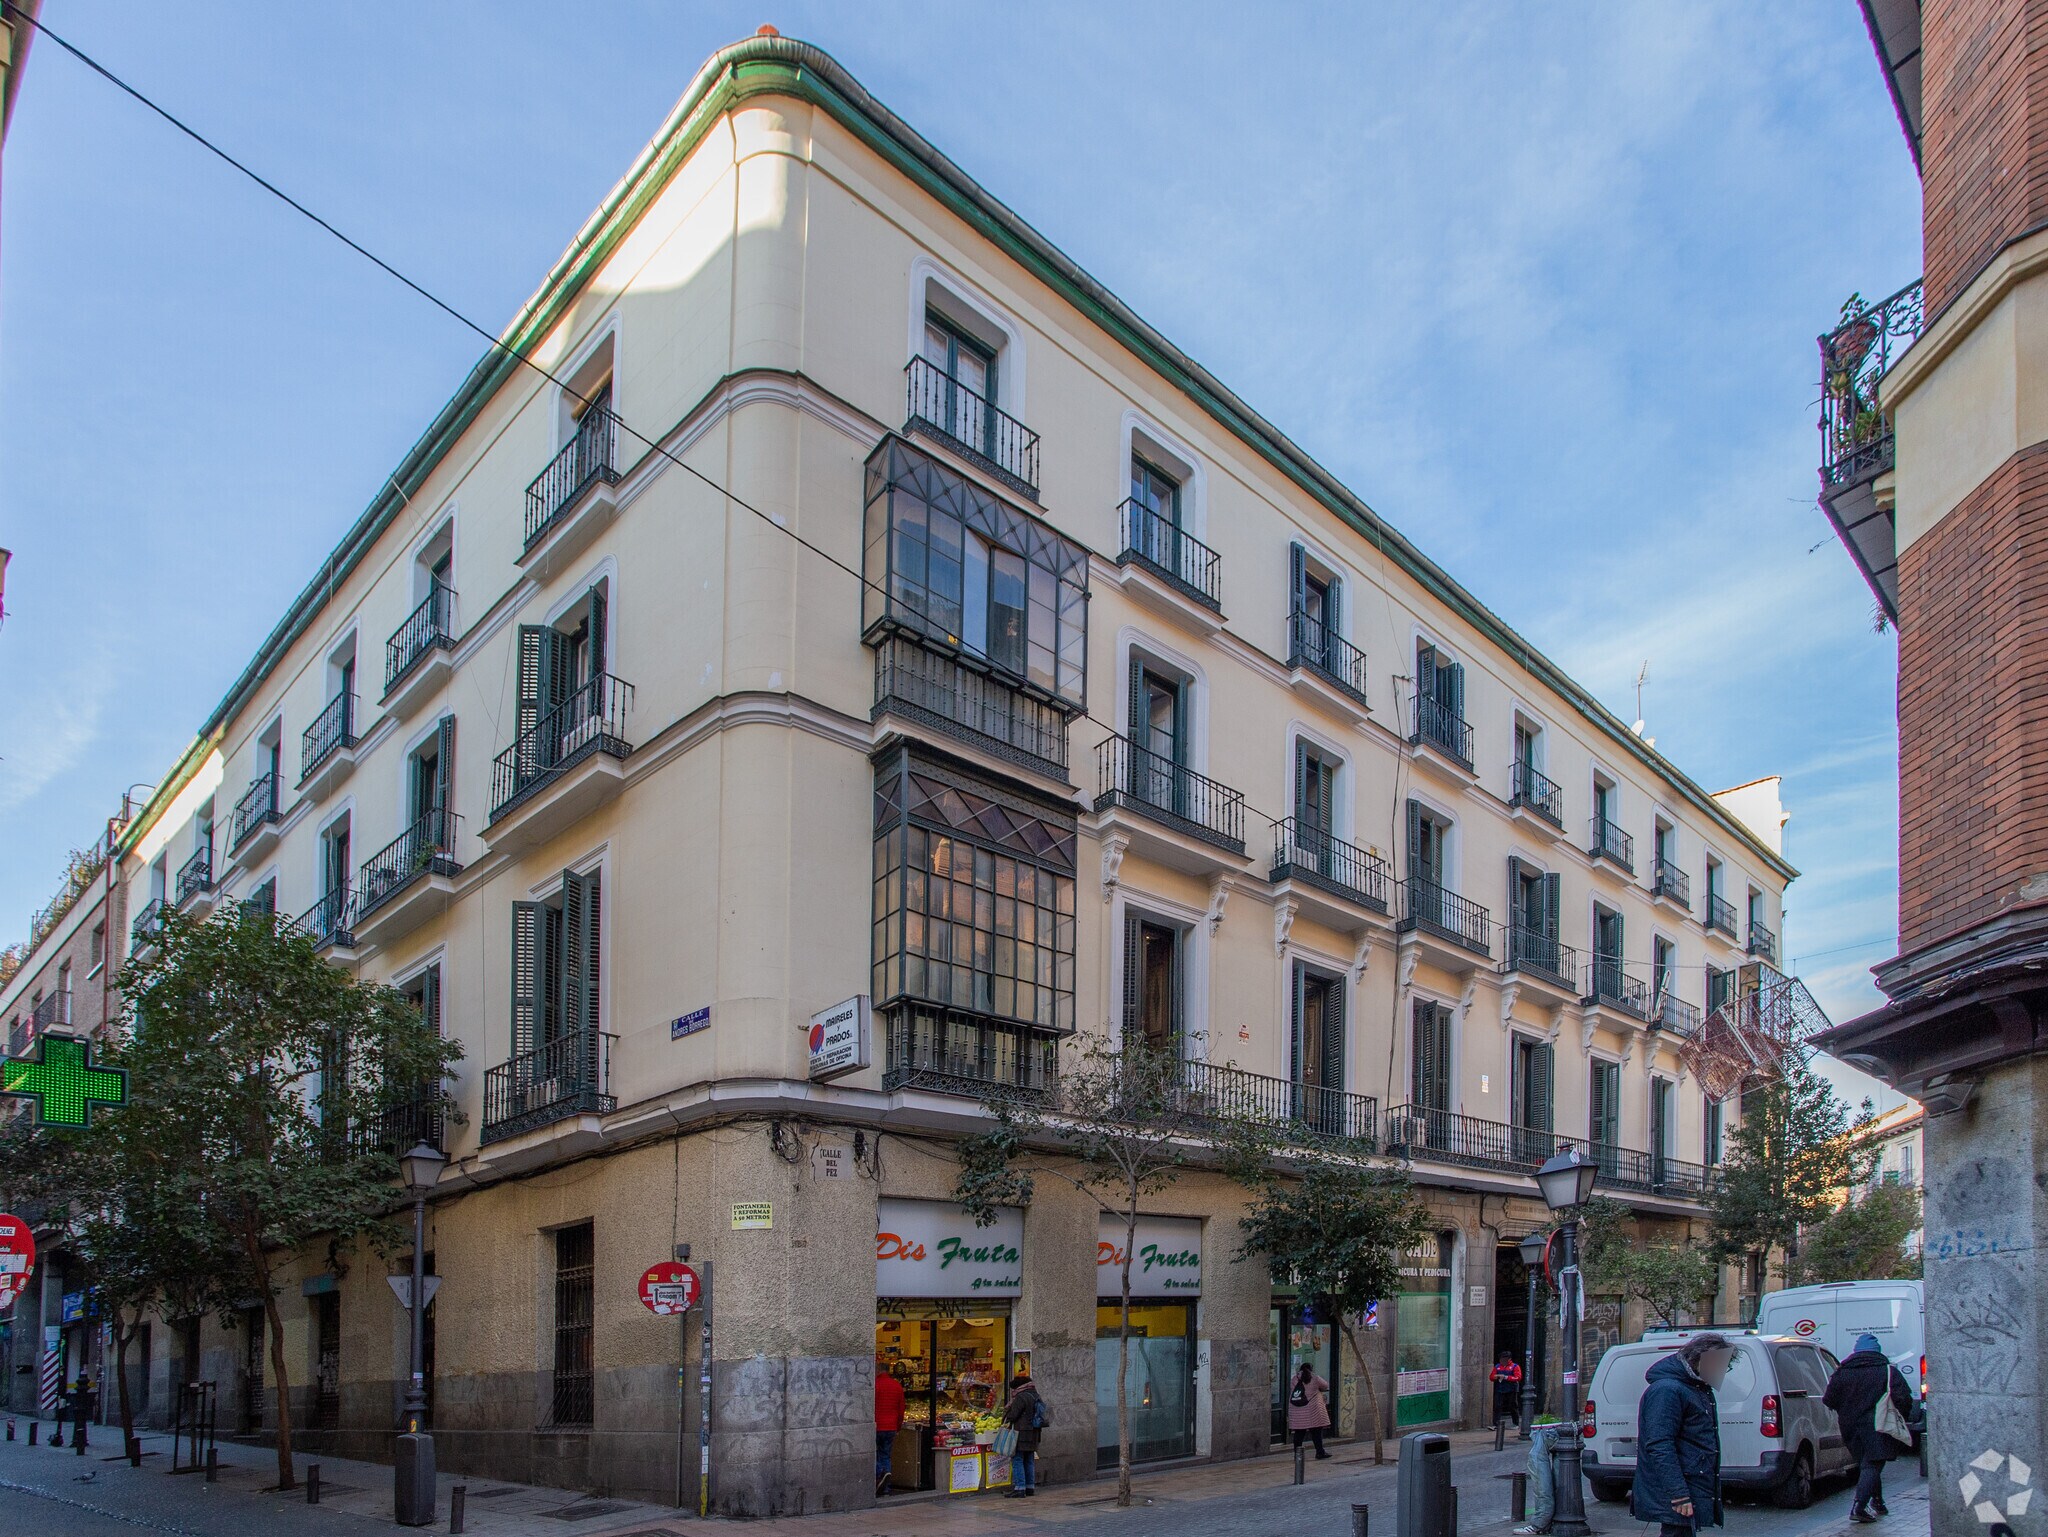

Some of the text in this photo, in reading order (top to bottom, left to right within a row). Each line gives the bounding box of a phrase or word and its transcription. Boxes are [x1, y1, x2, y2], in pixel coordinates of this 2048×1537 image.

[681, 1010, 704, 1023] CALLE
[825, 1009, 853, 1029] MAIRELES
[826, 1030, 850, 1046] PRADOS
[836, 1052, 852, 1064] OFICINA
[822, 1149, 842, 1159] CALLE
[826, 1159, 838, 1167] DEL
[826, 1168, 838, 1178] PEZ
[876, 1232, 1020, 1270] Dis Fruta
[1140, 1244, 1200, 1274] Fruta
[1418, 1268, 1424, 1277] Y
[971, 1276, 1021, 1290] A tu salud
[1163, 1278, 1200, 1290] A tu salud
[952, 1445, 980, 1456] OFERTA
